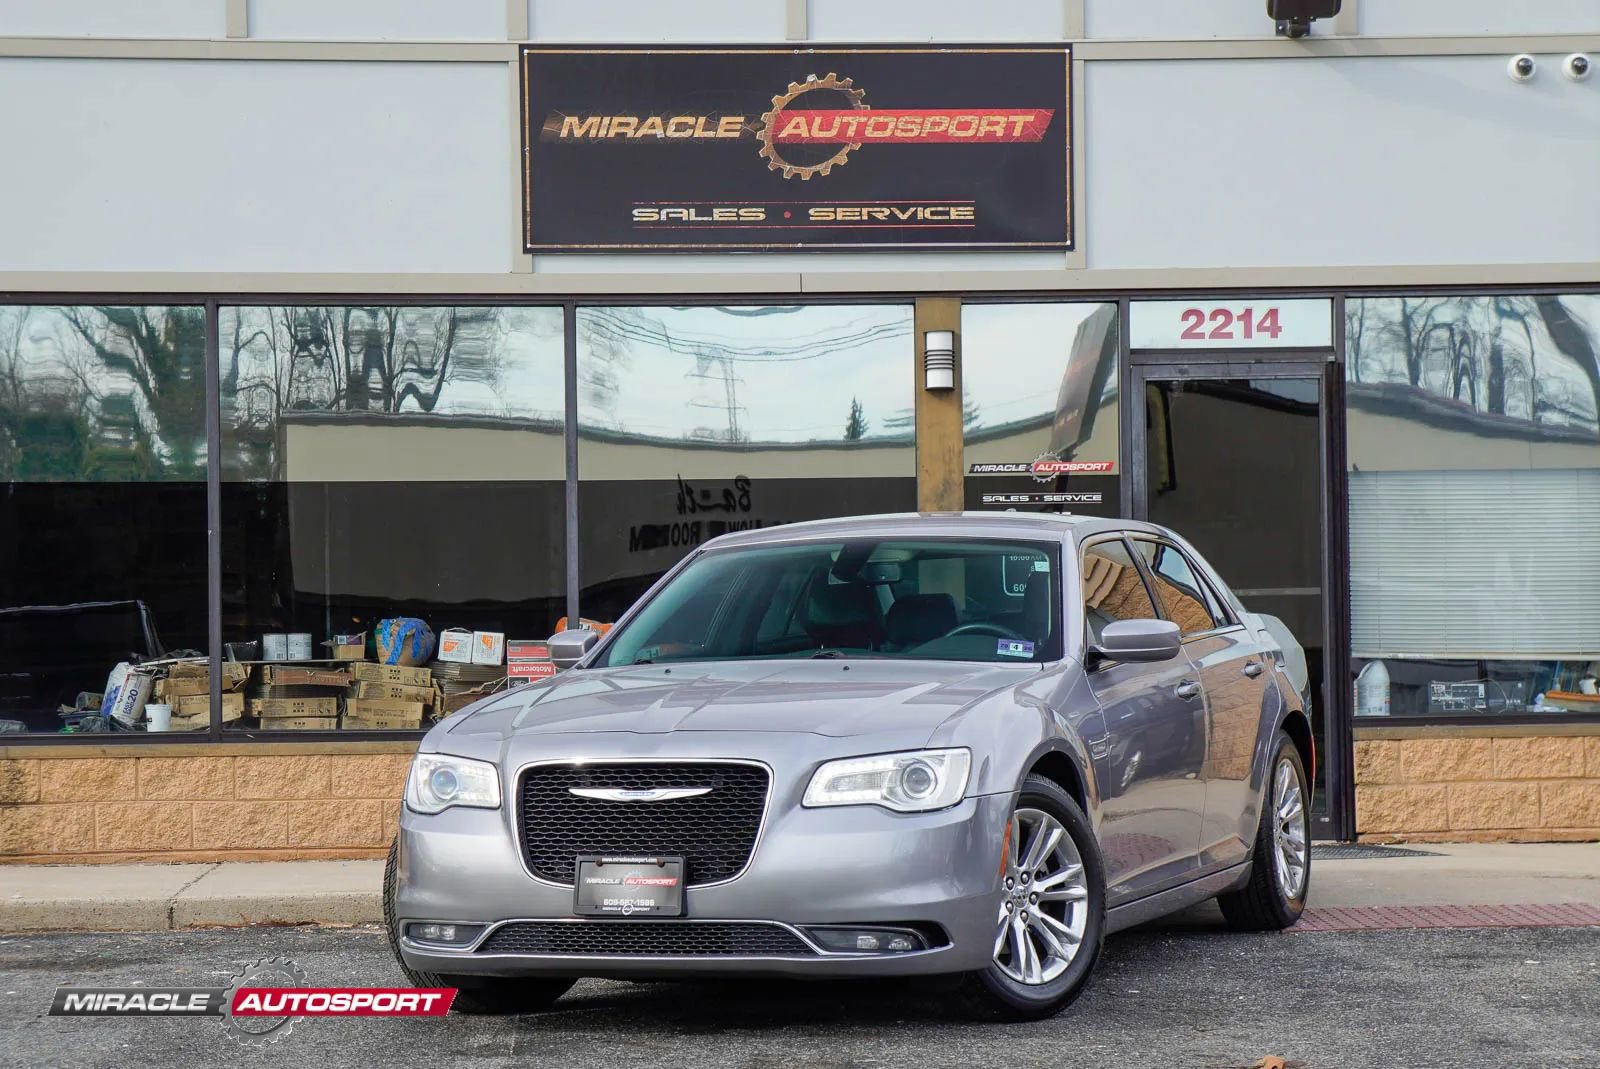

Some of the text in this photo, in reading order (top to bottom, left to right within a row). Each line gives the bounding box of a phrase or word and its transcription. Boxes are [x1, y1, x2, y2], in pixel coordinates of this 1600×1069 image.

[560, 115, 1035, 138] MIRACLE AUTOSPORT
[632, 205, 976, 222] SALES SERVICE
[1180, 308, 1282, 340] 2214
[973, 462, 1110, 472] MIRACLE AUTOSPORT
[982, 494, 1103, 503] SALES SERVICE
[128, 689, 138, 702] 20
